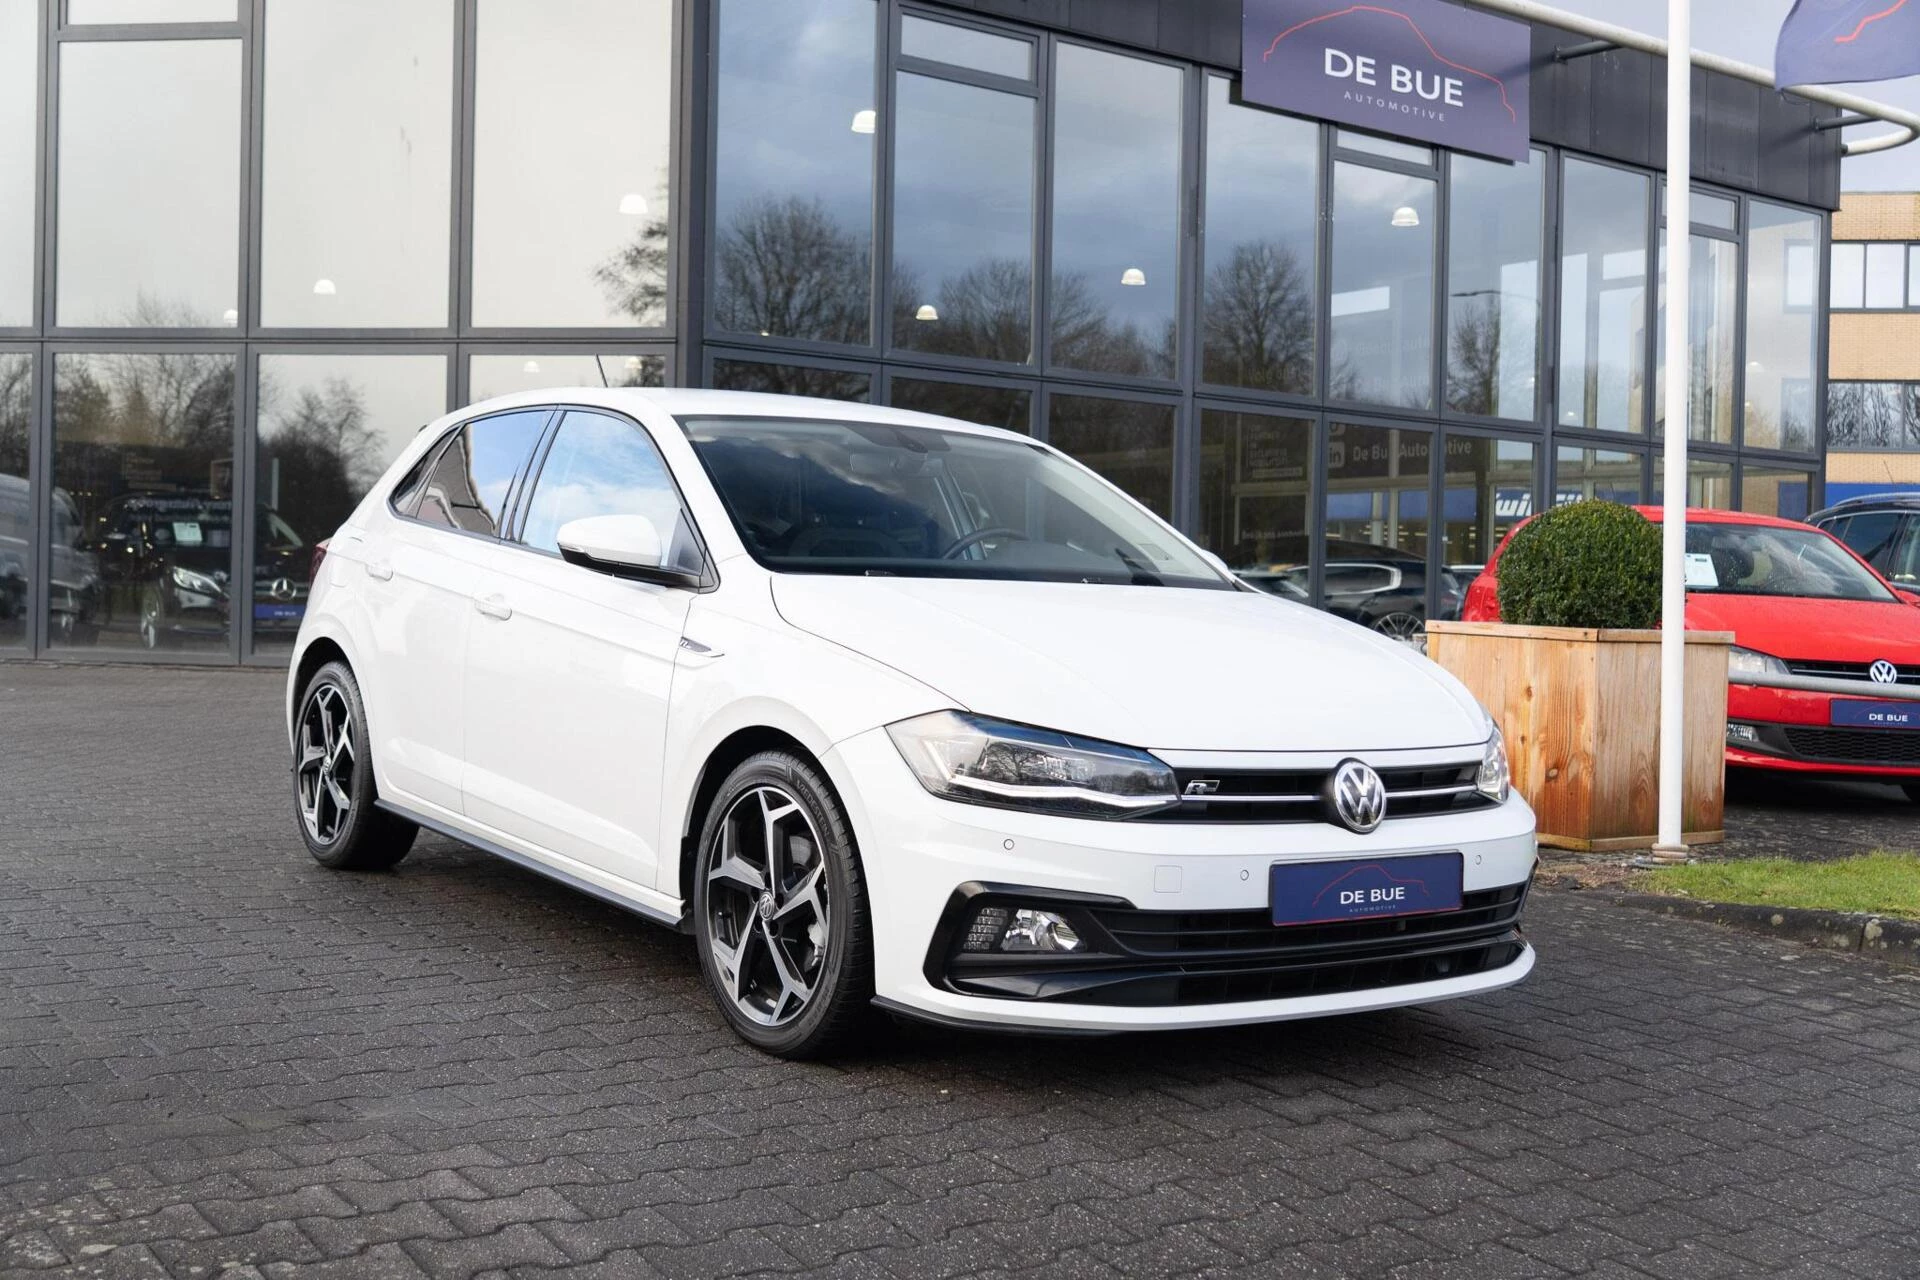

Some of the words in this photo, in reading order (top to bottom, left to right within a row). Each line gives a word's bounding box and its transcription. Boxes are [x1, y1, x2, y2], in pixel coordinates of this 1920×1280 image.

[1324, 47, 1377, 86] DE
[1390, 63, 1464, 108] BUE
[1343, 90, 1446, 122] AUTOMOTIVE
[1352, 445, 1369, 461] De
[1371, 442, 1390, 460] Bu
[1868, 713, 1884, 721] DE
[1886, 714, 1908, 722] BUE
[1339, 890, 1365, 905] DE
[1370, 886, 1406, 902] BUE
